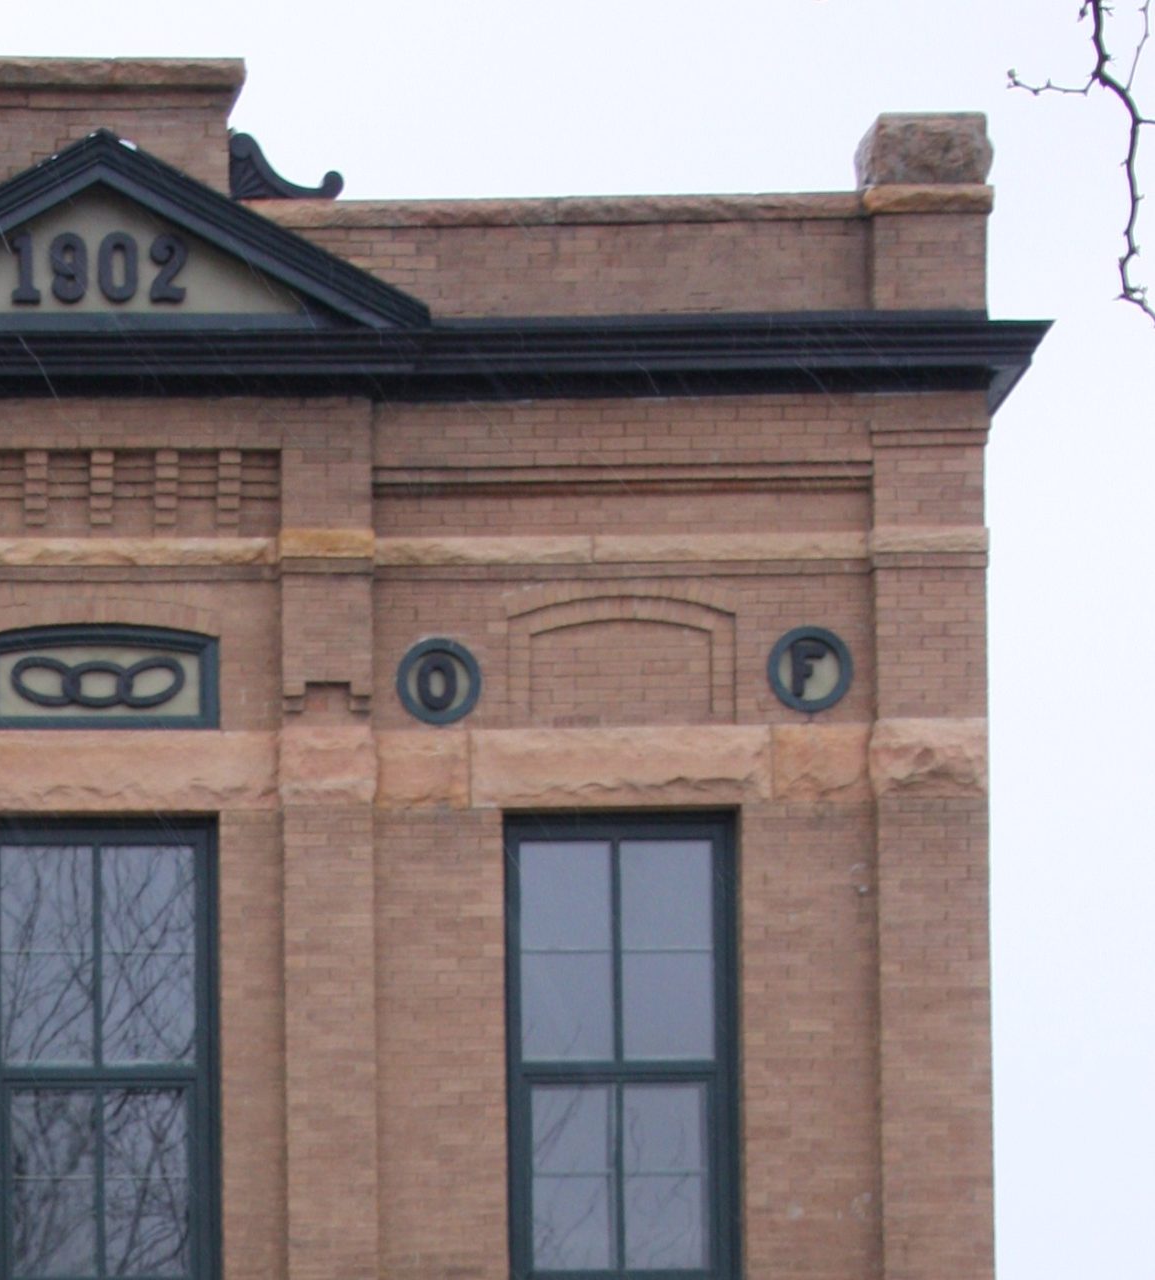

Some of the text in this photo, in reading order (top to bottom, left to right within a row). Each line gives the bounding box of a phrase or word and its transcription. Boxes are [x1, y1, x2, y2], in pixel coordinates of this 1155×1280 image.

[11, 231, 189, 306] 1902
[416, 653, 458, 711] O
[791, 642, 827, 698] F
